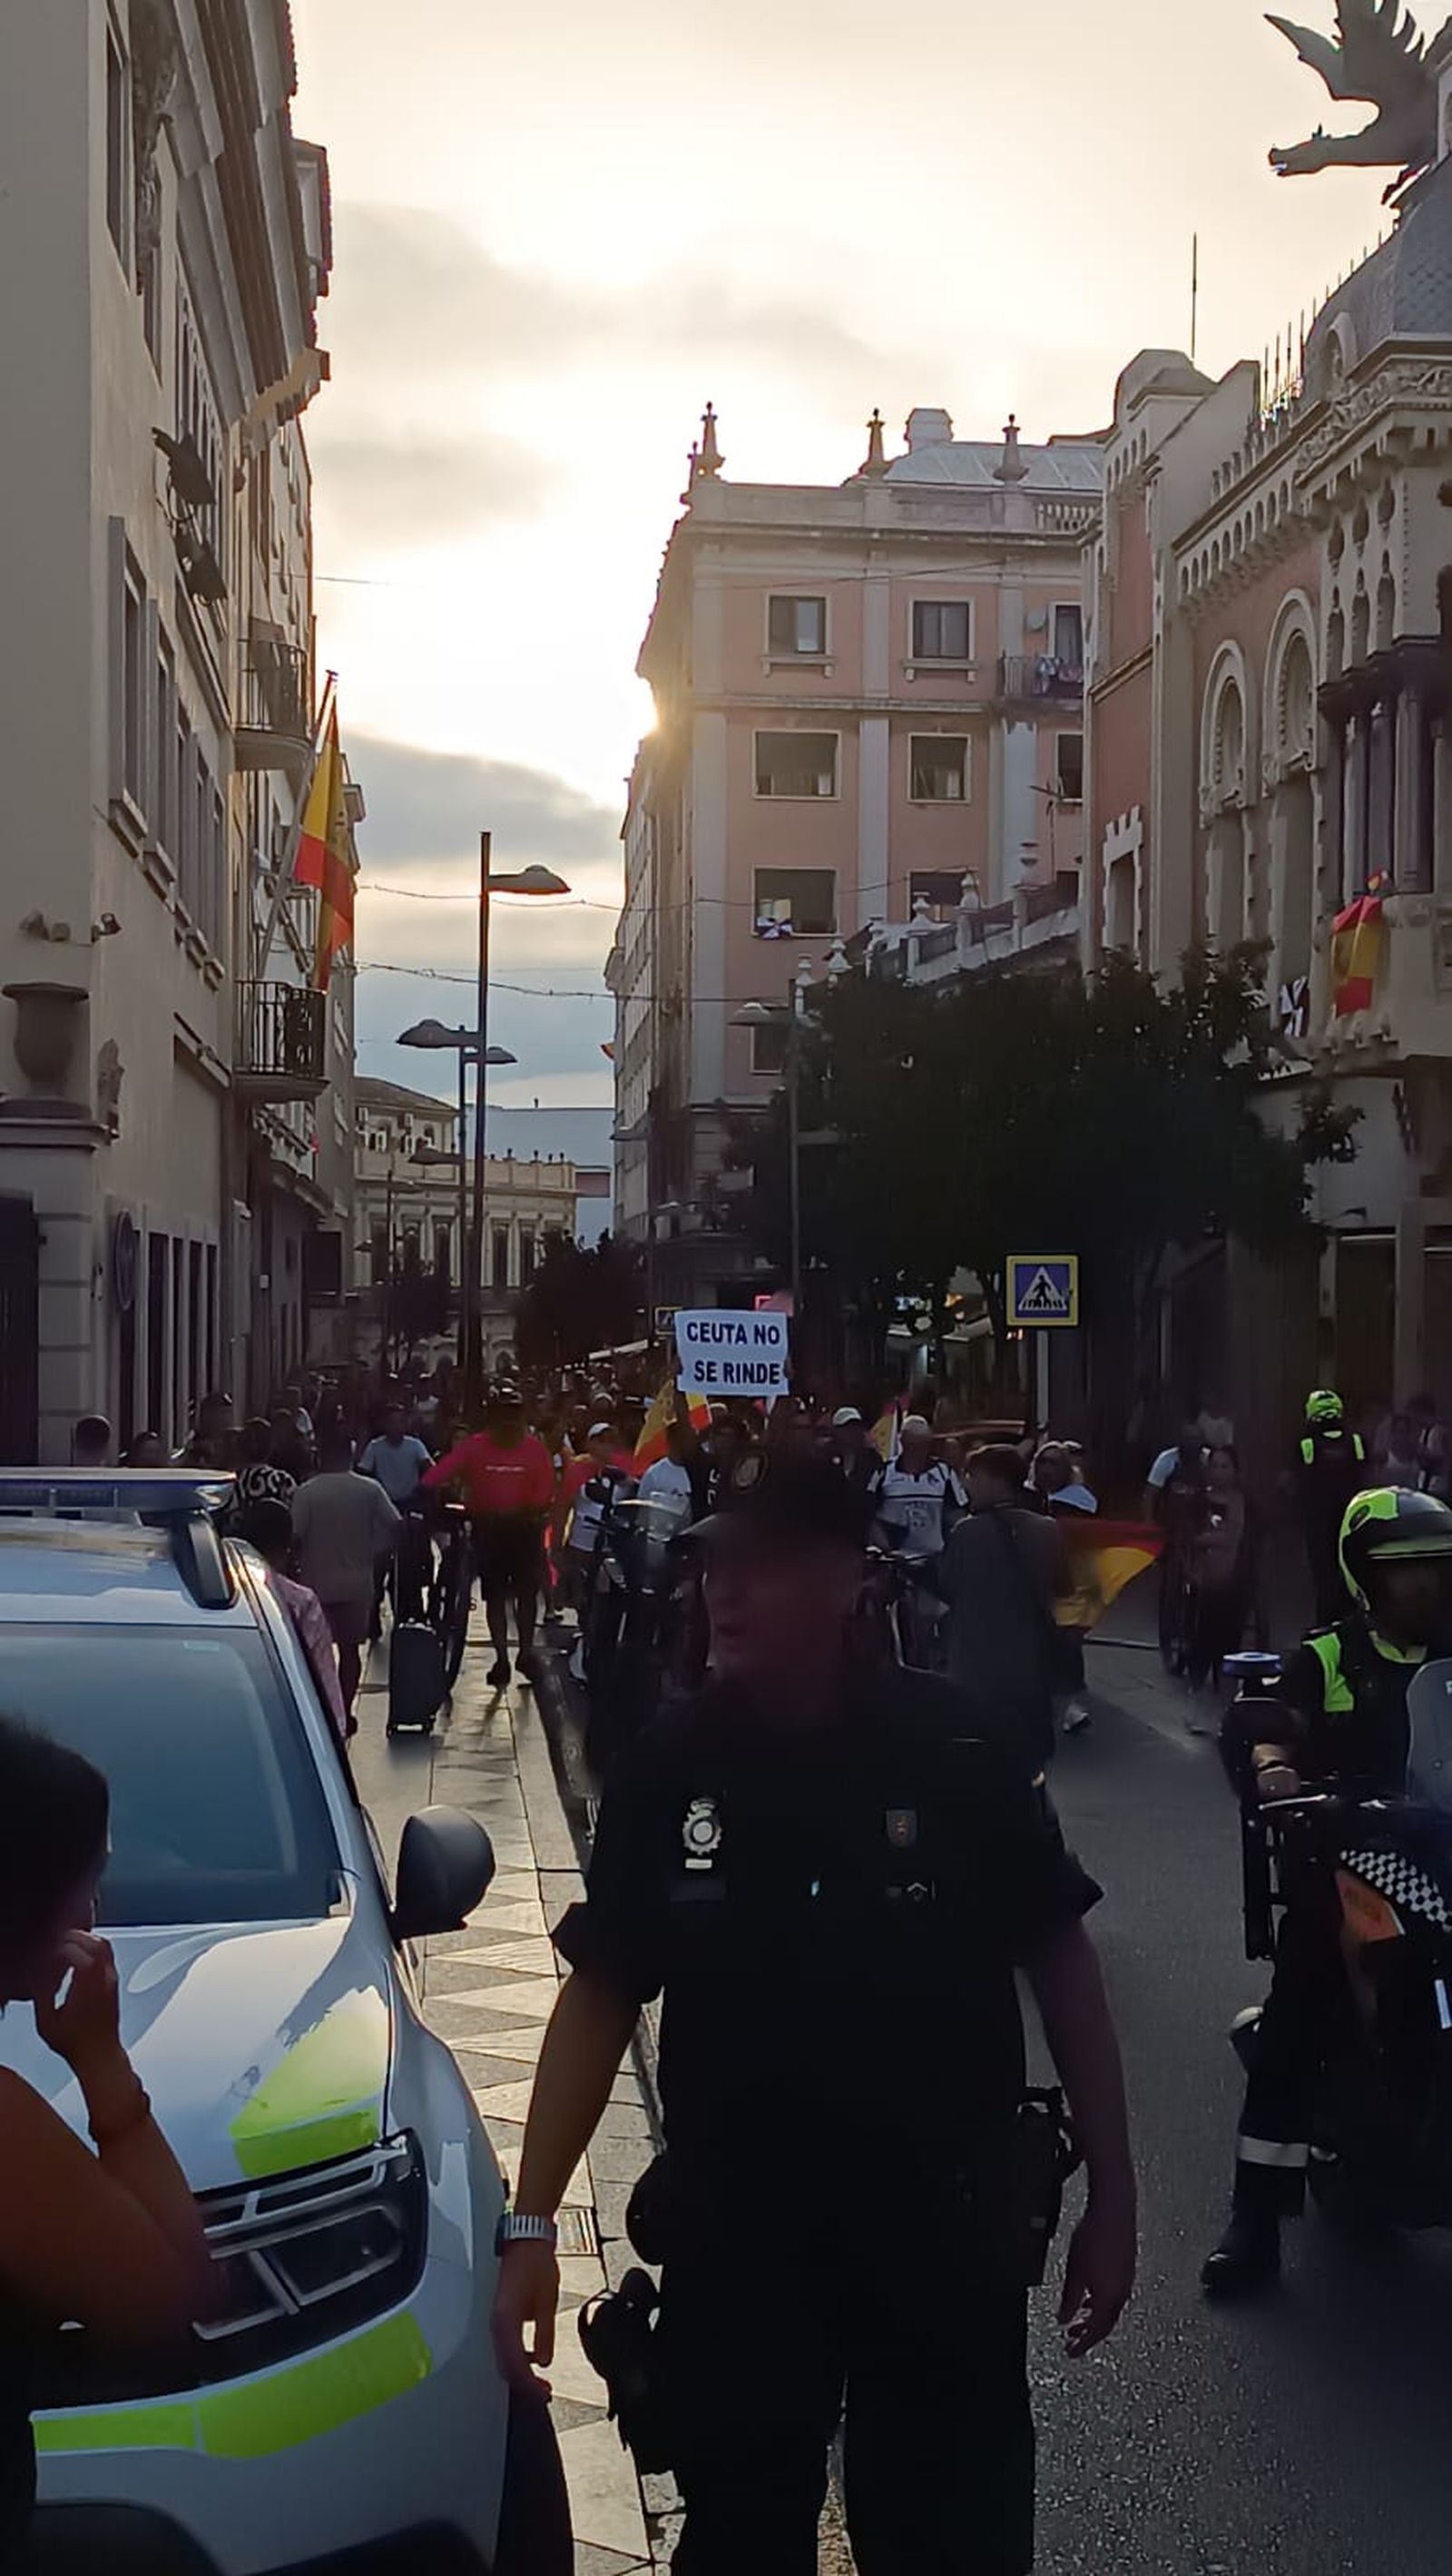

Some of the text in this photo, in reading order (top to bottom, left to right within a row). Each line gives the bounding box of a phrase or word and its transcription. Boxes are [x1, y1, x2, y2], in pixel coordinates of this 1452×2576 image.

[687, 1322, 780, 1345] CEUTA NO
[694, 1361, 780, 1385] SE RINDE
